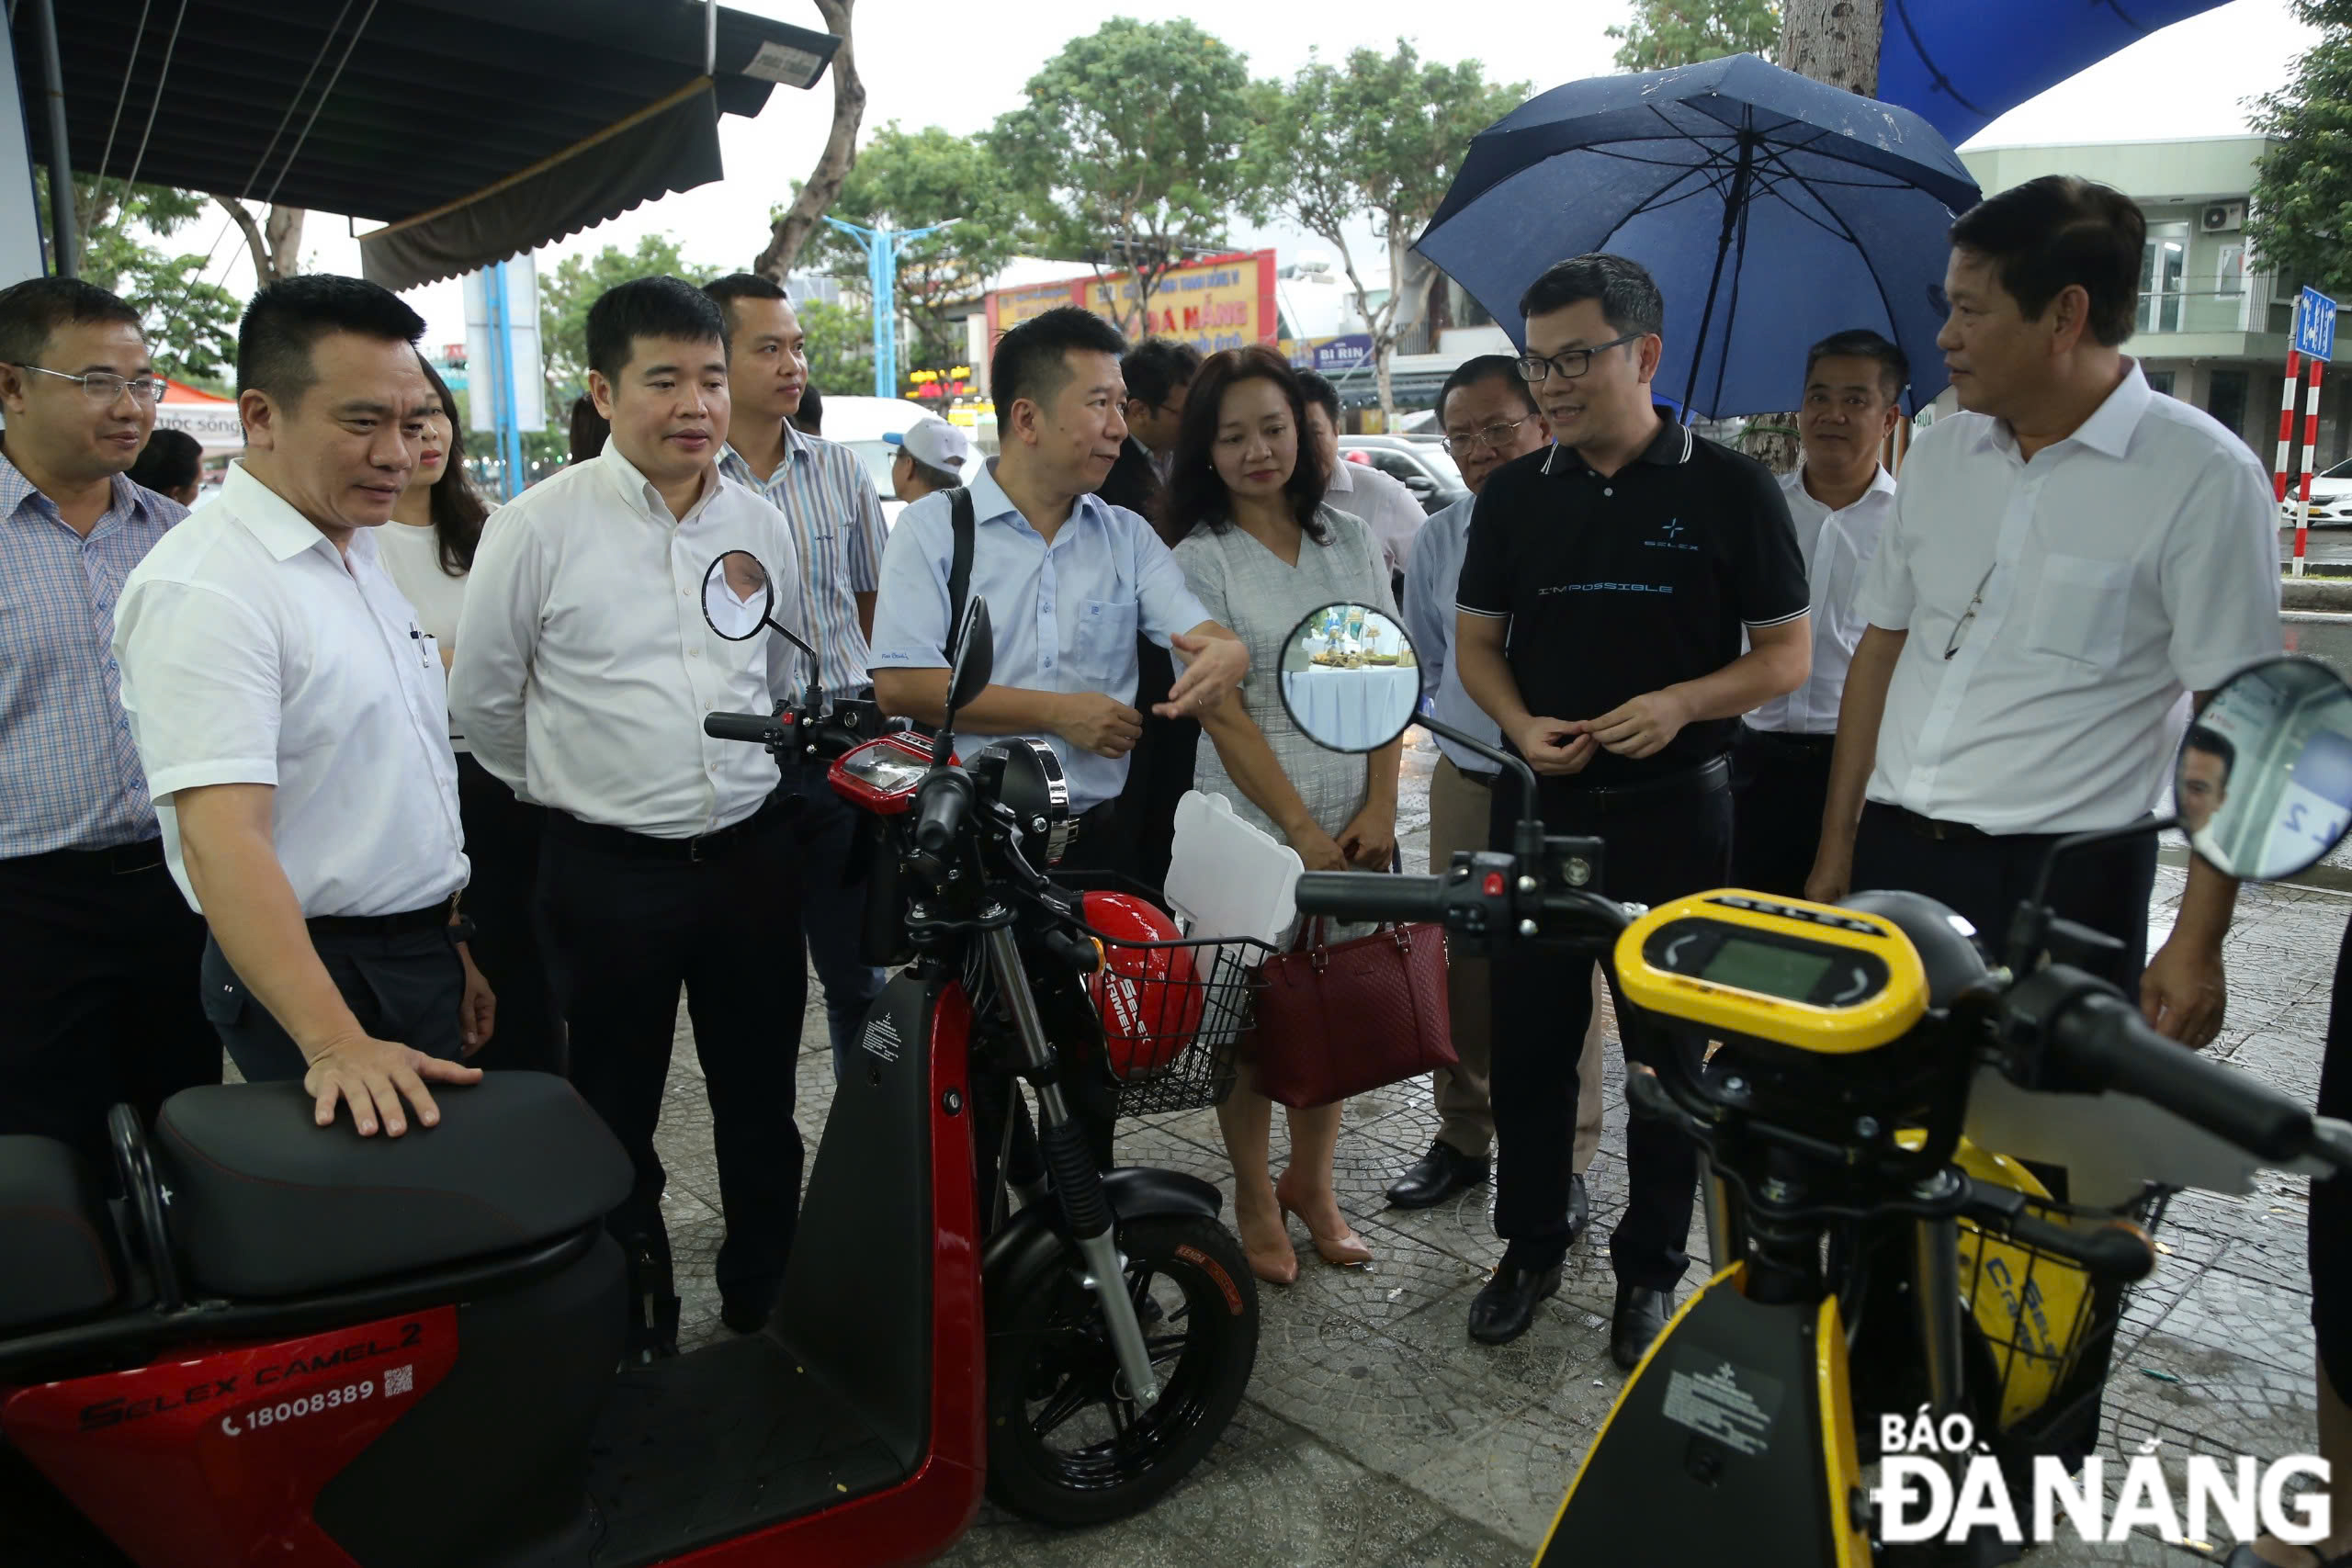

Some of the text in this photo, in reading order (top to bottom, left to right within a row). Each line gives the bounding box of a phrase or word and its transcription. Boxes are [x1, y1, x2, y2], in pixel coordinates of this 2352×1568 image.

[1338, 346, 1363, 359] RIN
[1644, 540, 1699, 551] SELEX
[78, 1322, 423, 1432] SELEX CAMEL 2
[247, 1380, 375, 1430] 18008389
